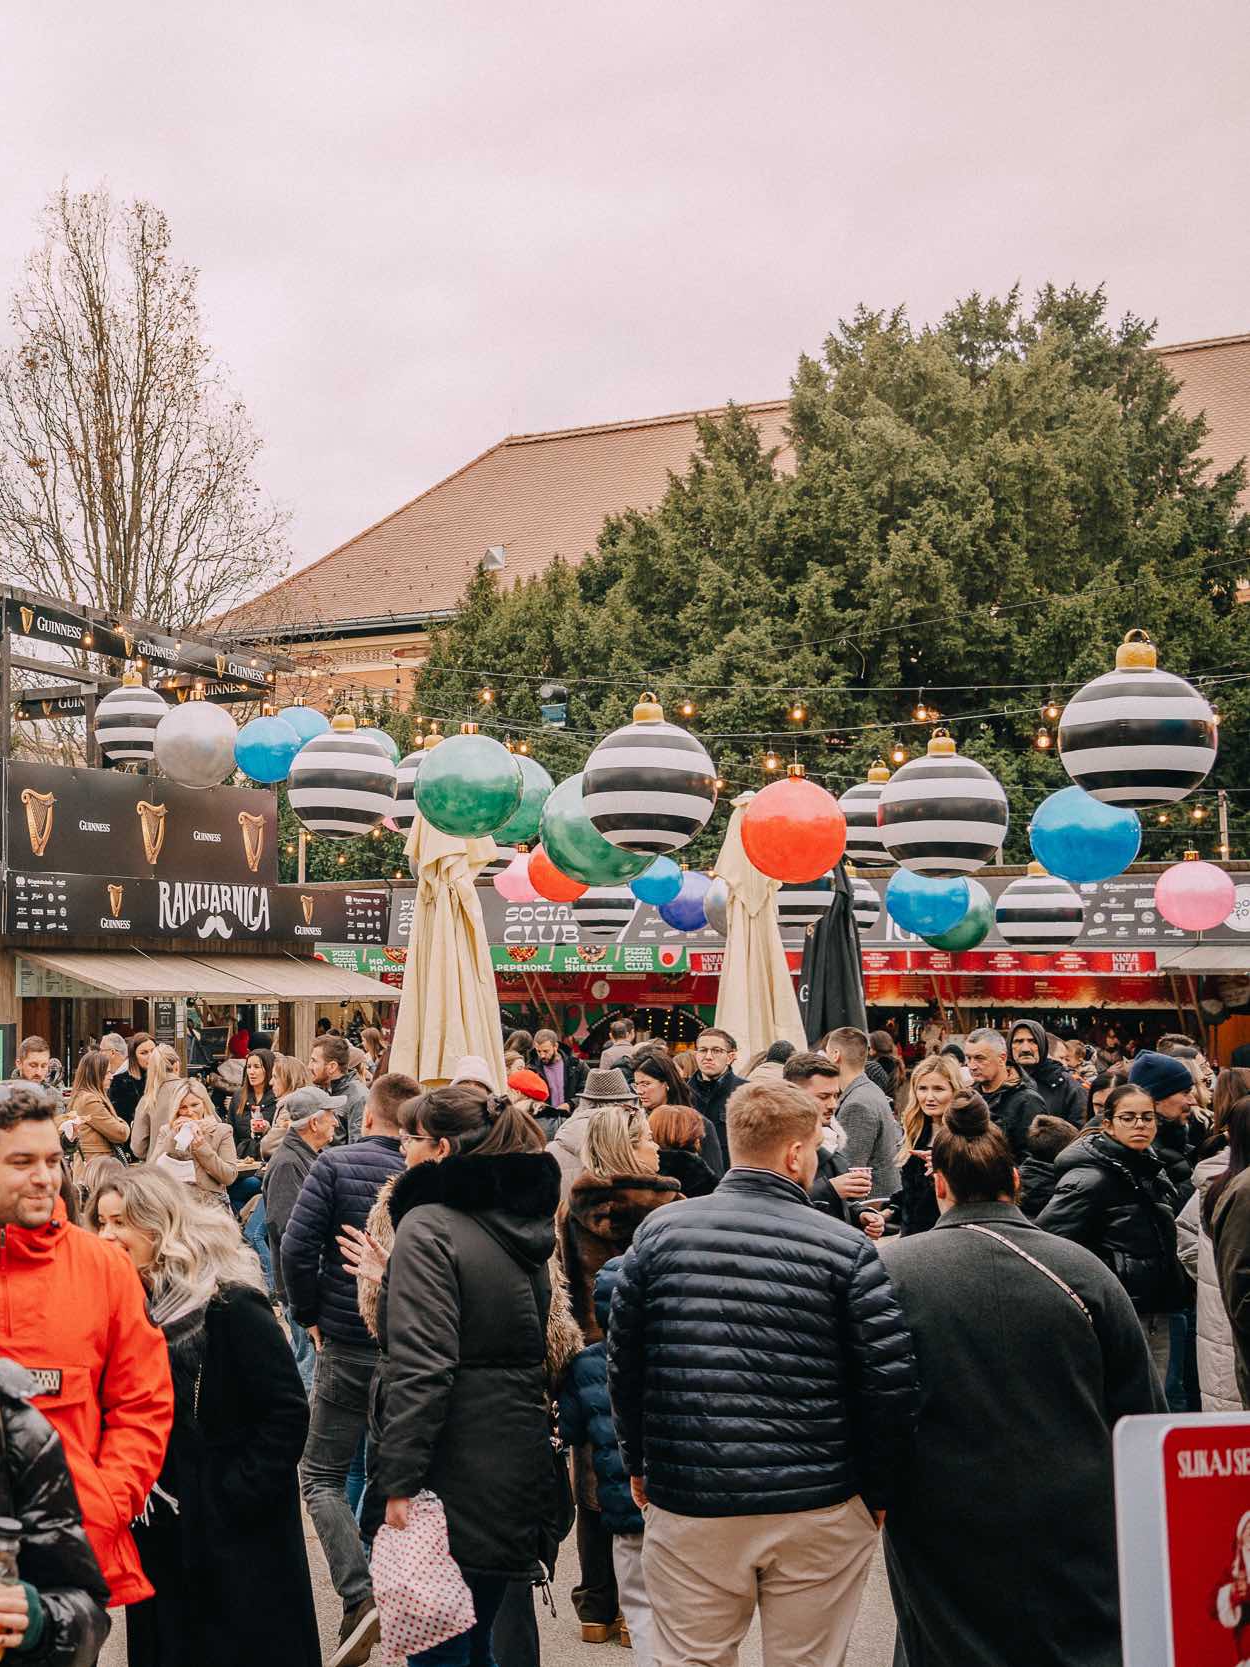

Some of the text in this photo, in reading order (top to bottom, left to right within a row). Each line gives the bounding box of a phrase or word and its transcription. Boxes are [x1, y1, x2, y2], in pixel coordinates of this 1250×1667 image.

[37, 616, 83, 640] GUINNESS
[228, 662, 265, 681] GUINNESS
[78, 820, 110, 833] GUINNESS
[193, 830, 222, 843] GUINNESS
[158, 881, 271, 932] RAKIJARNICA
[101, 917, 132, 930] GUINNESS
[294, 925, 322, 936] GUINNESS
[503, 925, 580, 943] CLUB
[624, 962, 654, 971] CLUB
[1176, 1448, 1233, 1479] SLIKAJ
